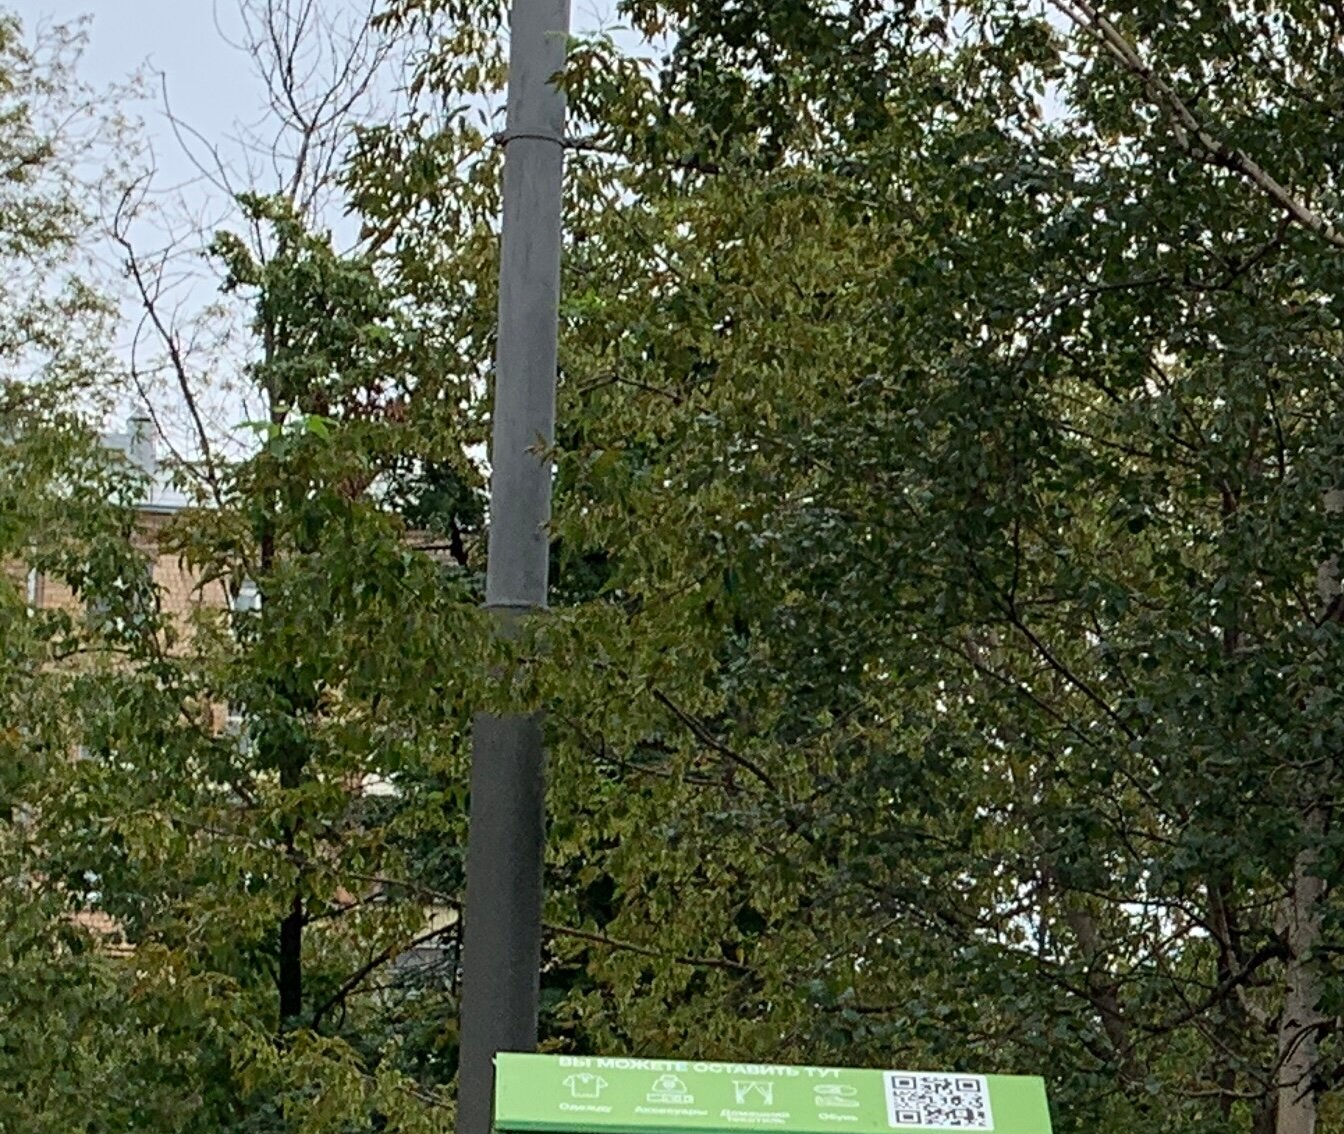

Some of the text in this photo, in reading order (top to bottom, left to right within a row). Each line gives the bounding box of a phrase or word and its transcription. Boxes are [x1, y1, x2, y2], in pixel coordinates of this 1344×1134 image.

[559, 1055, 843, 1079] ВЫ МОЖЕТЕ ОСТАВИТЬ ТУТ
